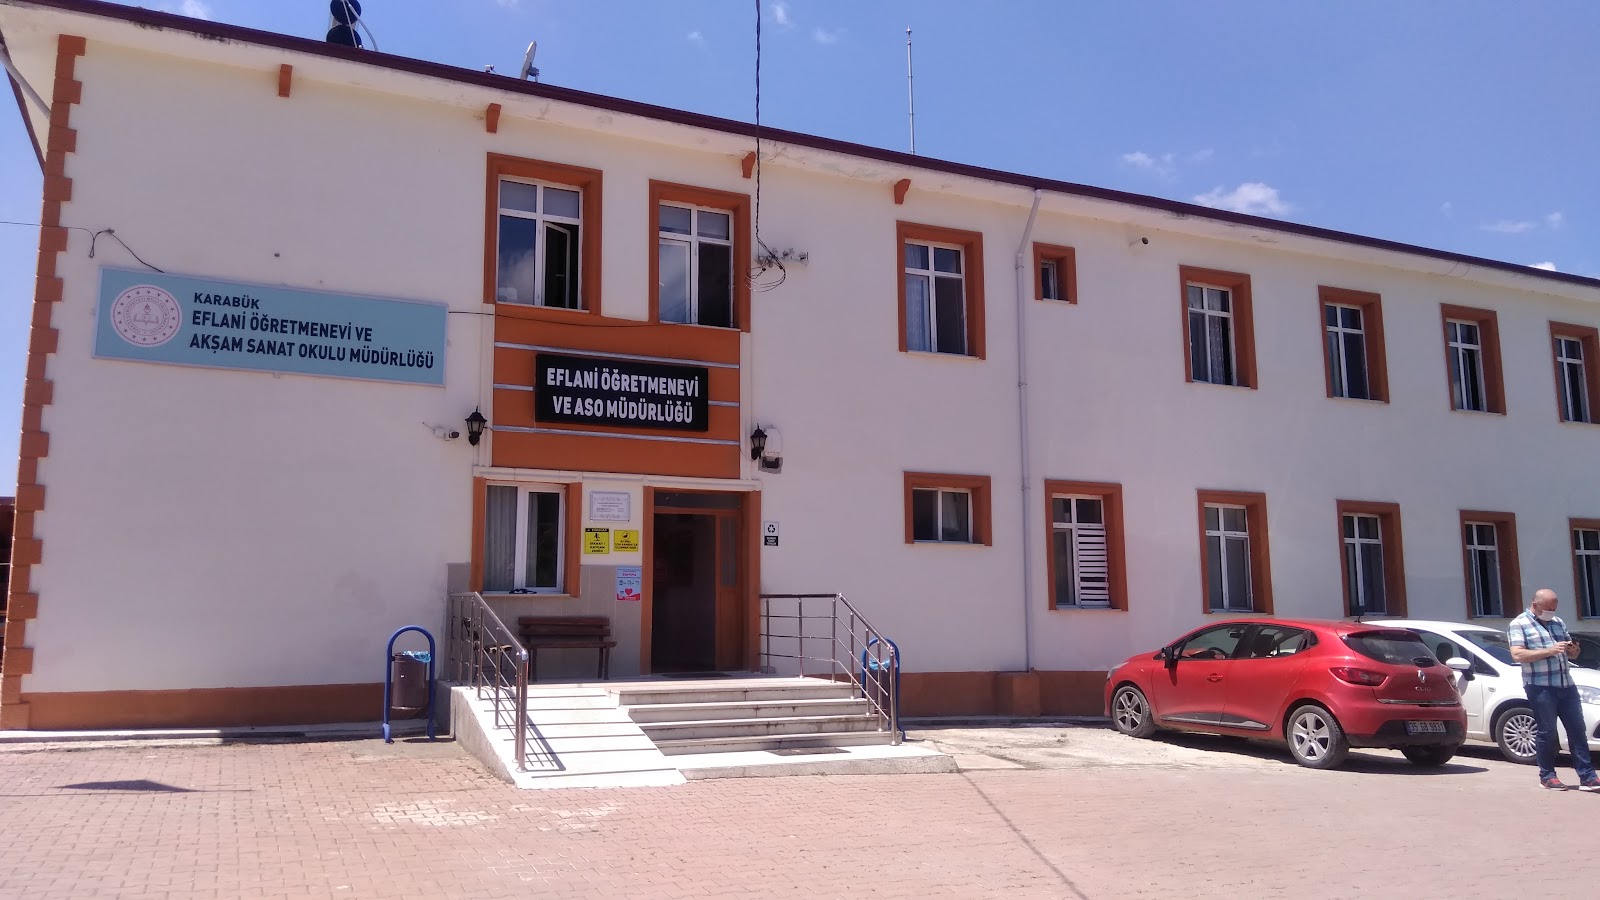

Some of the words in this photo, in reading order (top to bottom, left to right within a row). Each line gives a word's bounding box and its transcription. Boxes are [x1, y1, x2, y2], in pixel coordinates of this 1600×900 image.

[194, 292, 260, 309] KARABÜK
[192, 310, 246, 330] EFLANİ
[250, 312, 352, 340] ÖĞRETMENEVİ
[355, 326, 373, 342] VE
[189, 333, 243, 354] AKŞAM
[247, 338, 296, 357] SANAT
[299, 343, 346, 362] OKULU
[350, 347, 434, 369] MÜDÜRLÜĞÜ
[546, 367, 599, 390] EFLANİ
[601, 367, 699, 398] ÖĞRETMENEVİ
[552, 395, 572, 415] VE
[574, 397, 604, 417] ASO
[606, 396, 693, 424] MÜDÜRLÜĞÜ
